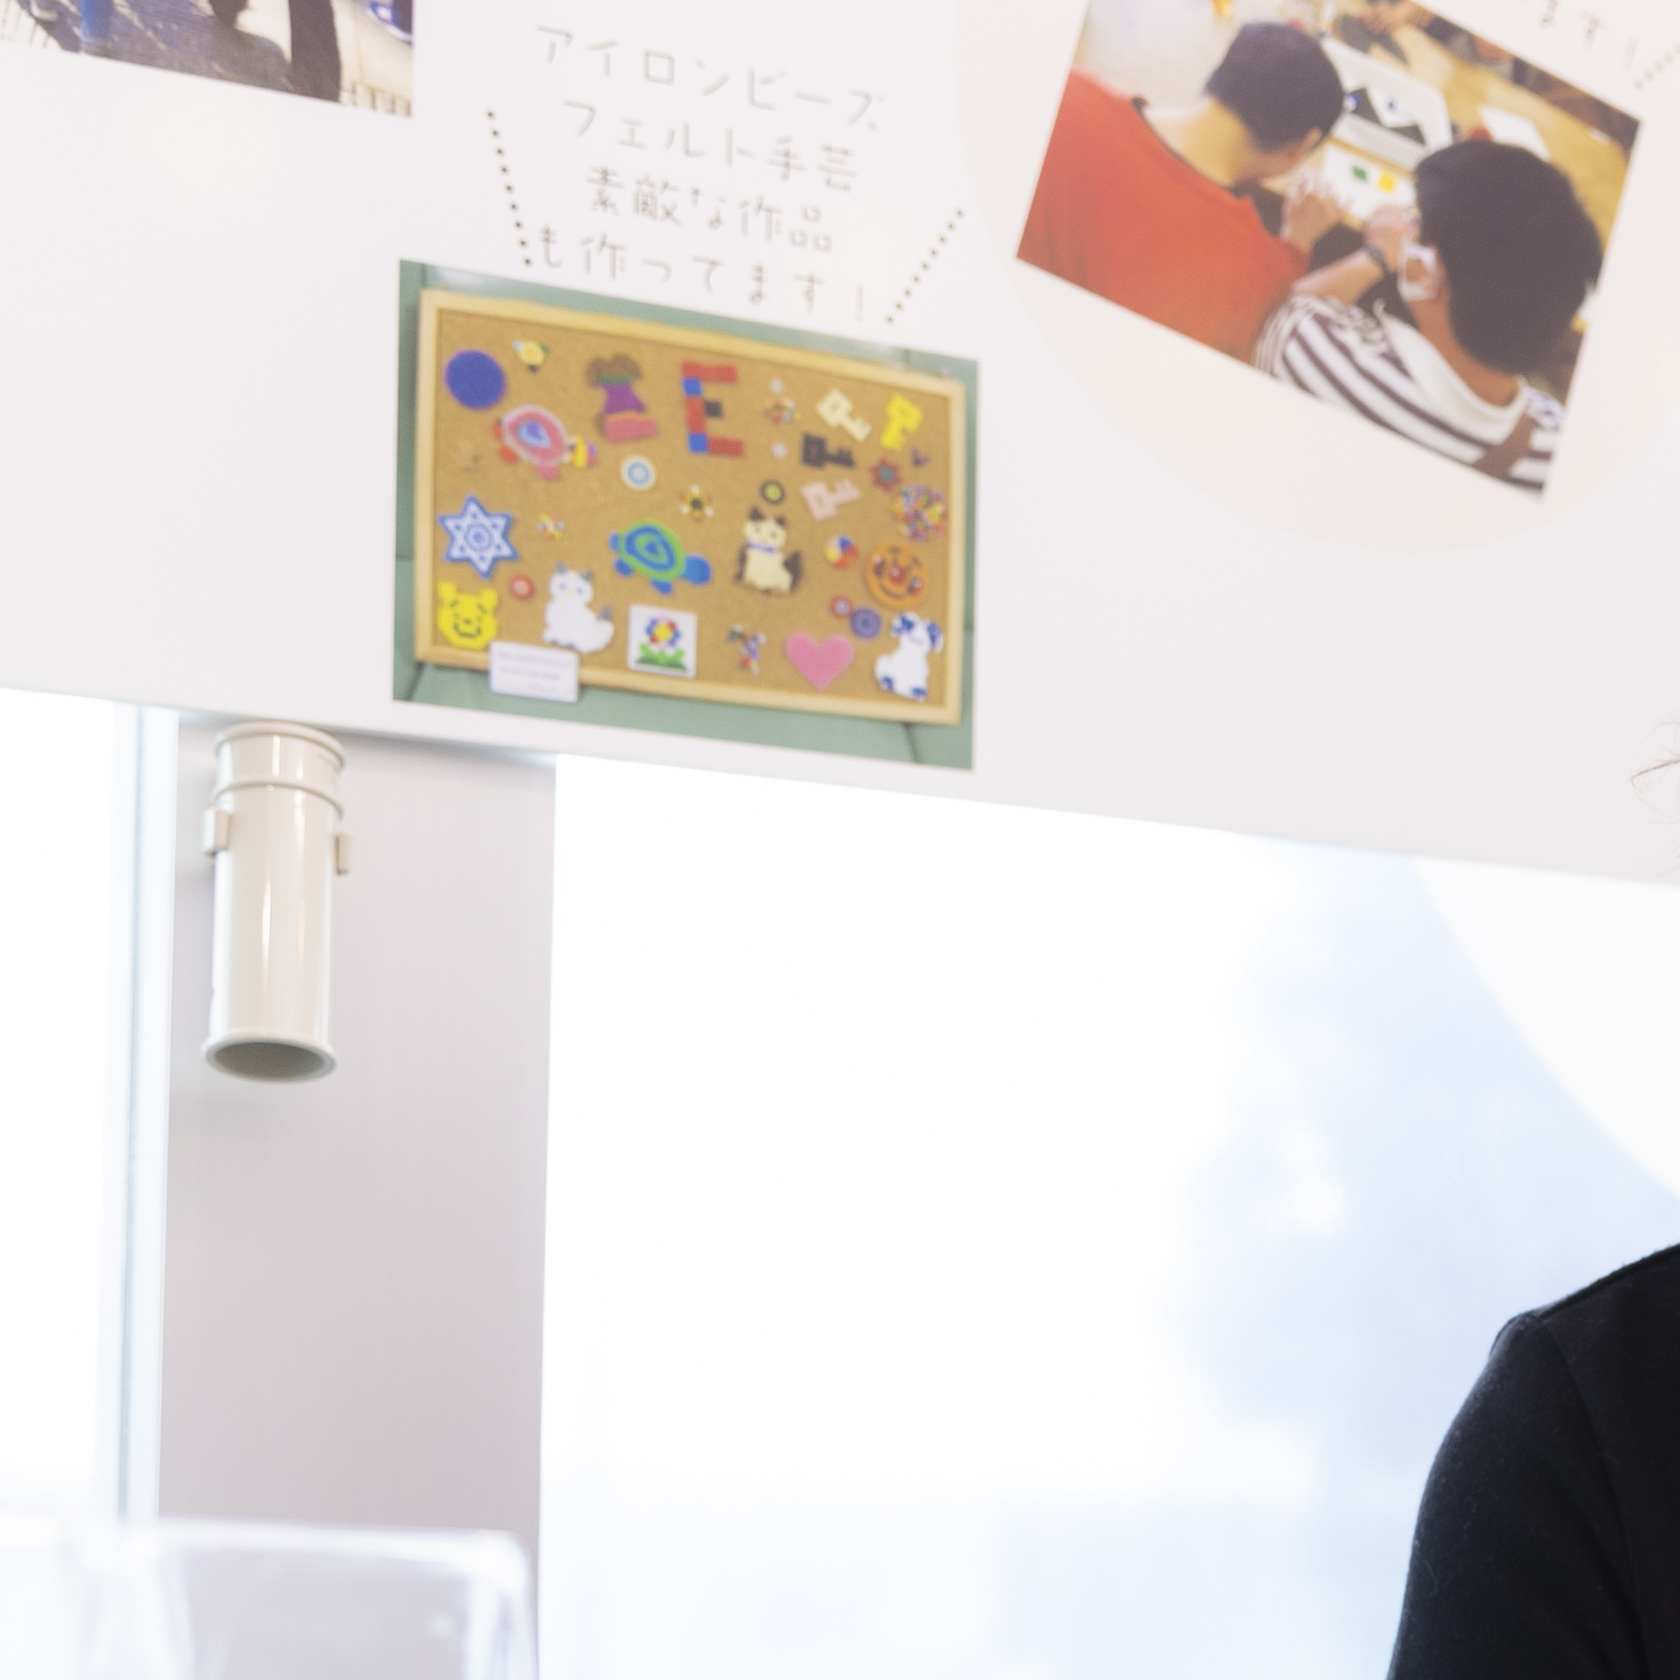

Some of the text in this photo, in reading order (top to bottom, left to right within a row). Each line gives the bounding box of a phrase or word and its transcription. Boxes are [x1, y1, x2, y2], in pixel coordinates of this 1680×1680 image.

[535, 24, 885, 132] アイロンビーズ
[562, 99, 858, 192] フェルト手芸
[584, 165, 833, 254] 素敵な作品
[539, 223, 864, 323] も作ってます!
